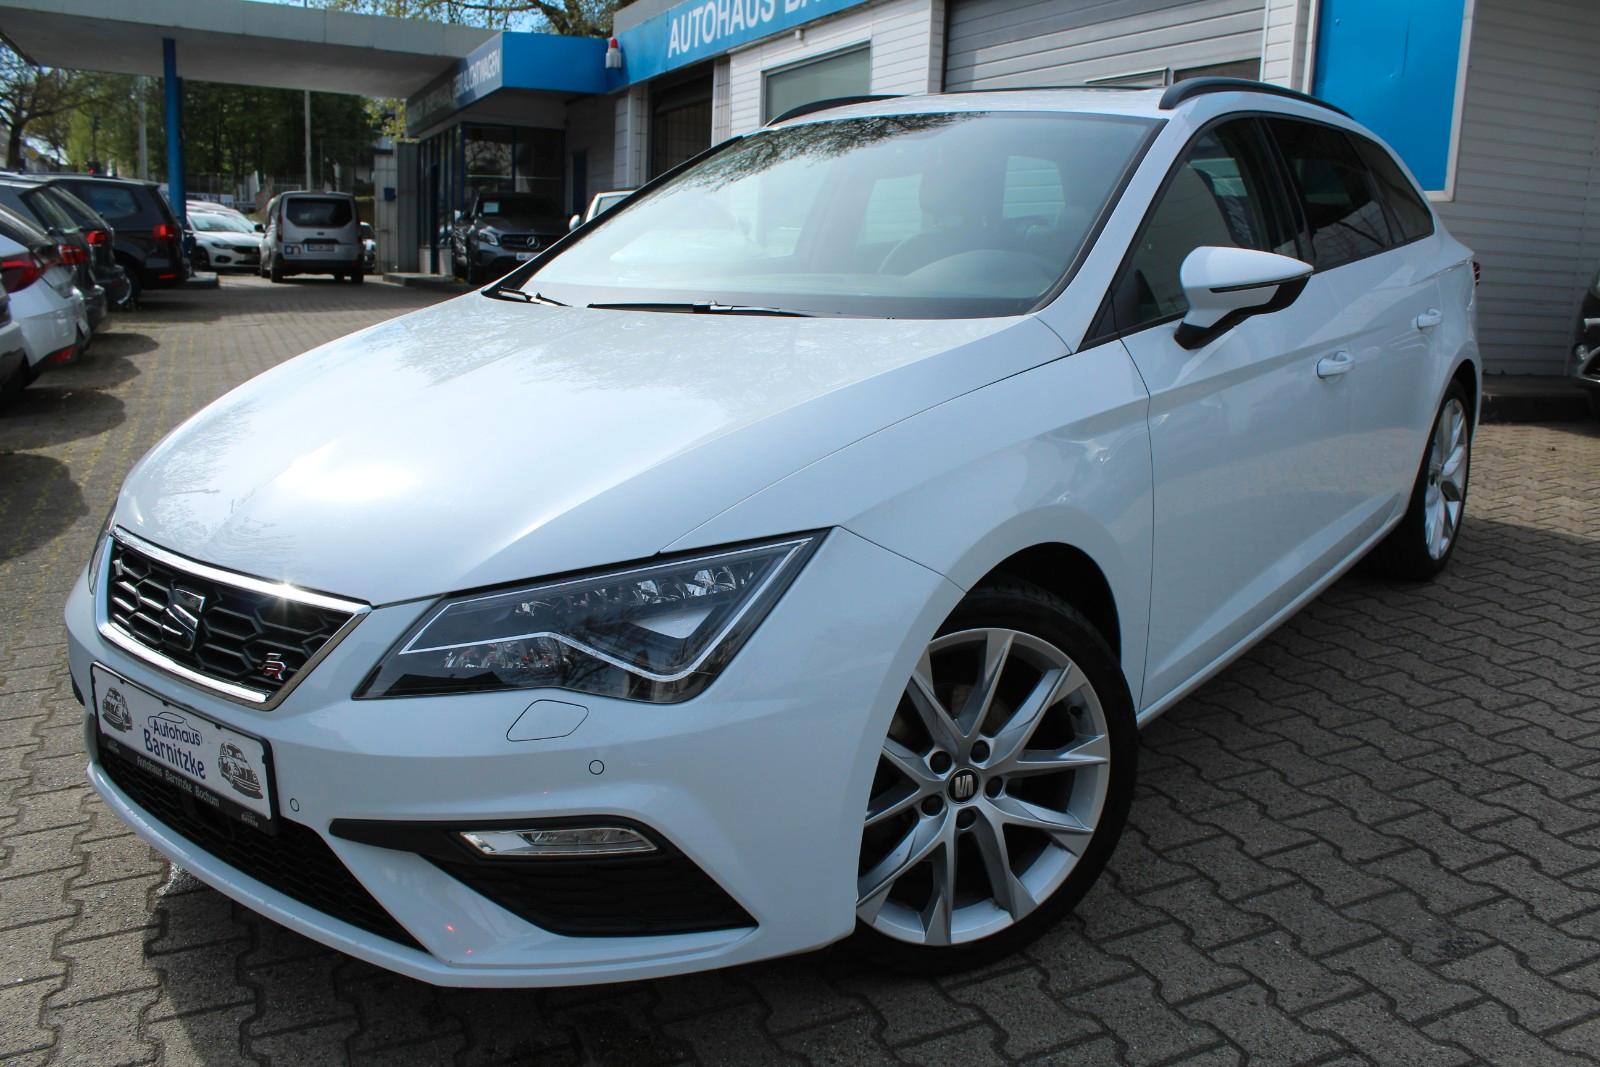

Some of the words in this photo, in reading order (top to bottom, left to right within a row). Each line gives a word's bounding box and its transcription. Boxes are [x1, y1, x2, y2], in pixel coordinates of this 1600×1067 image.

[667, 0, 776, 59] AUTOHAUS
[143, 728, 206, 780] Barnitzke
[152, 719, 201, 747] Autohaus
